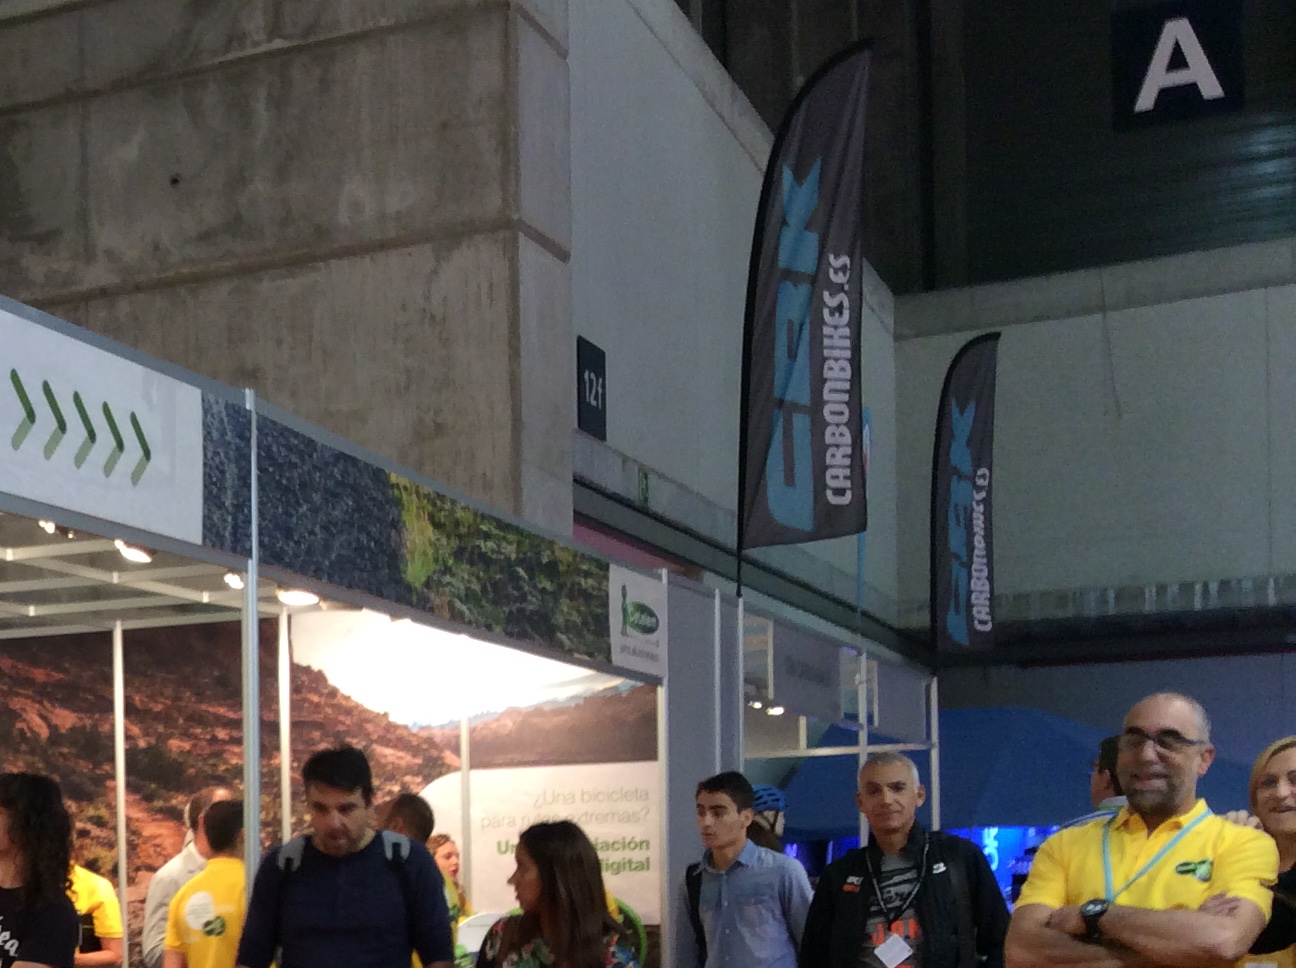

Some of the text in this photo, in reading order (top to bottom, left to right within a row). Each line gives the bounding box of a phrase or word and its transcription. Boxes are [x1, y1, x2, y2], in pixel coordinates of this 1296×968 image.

[1133, 17, 1225, 113] A
[823, 253, 853, 506] CARBONBIKES.ES
[581, 786, 650, 803] bicicleta
